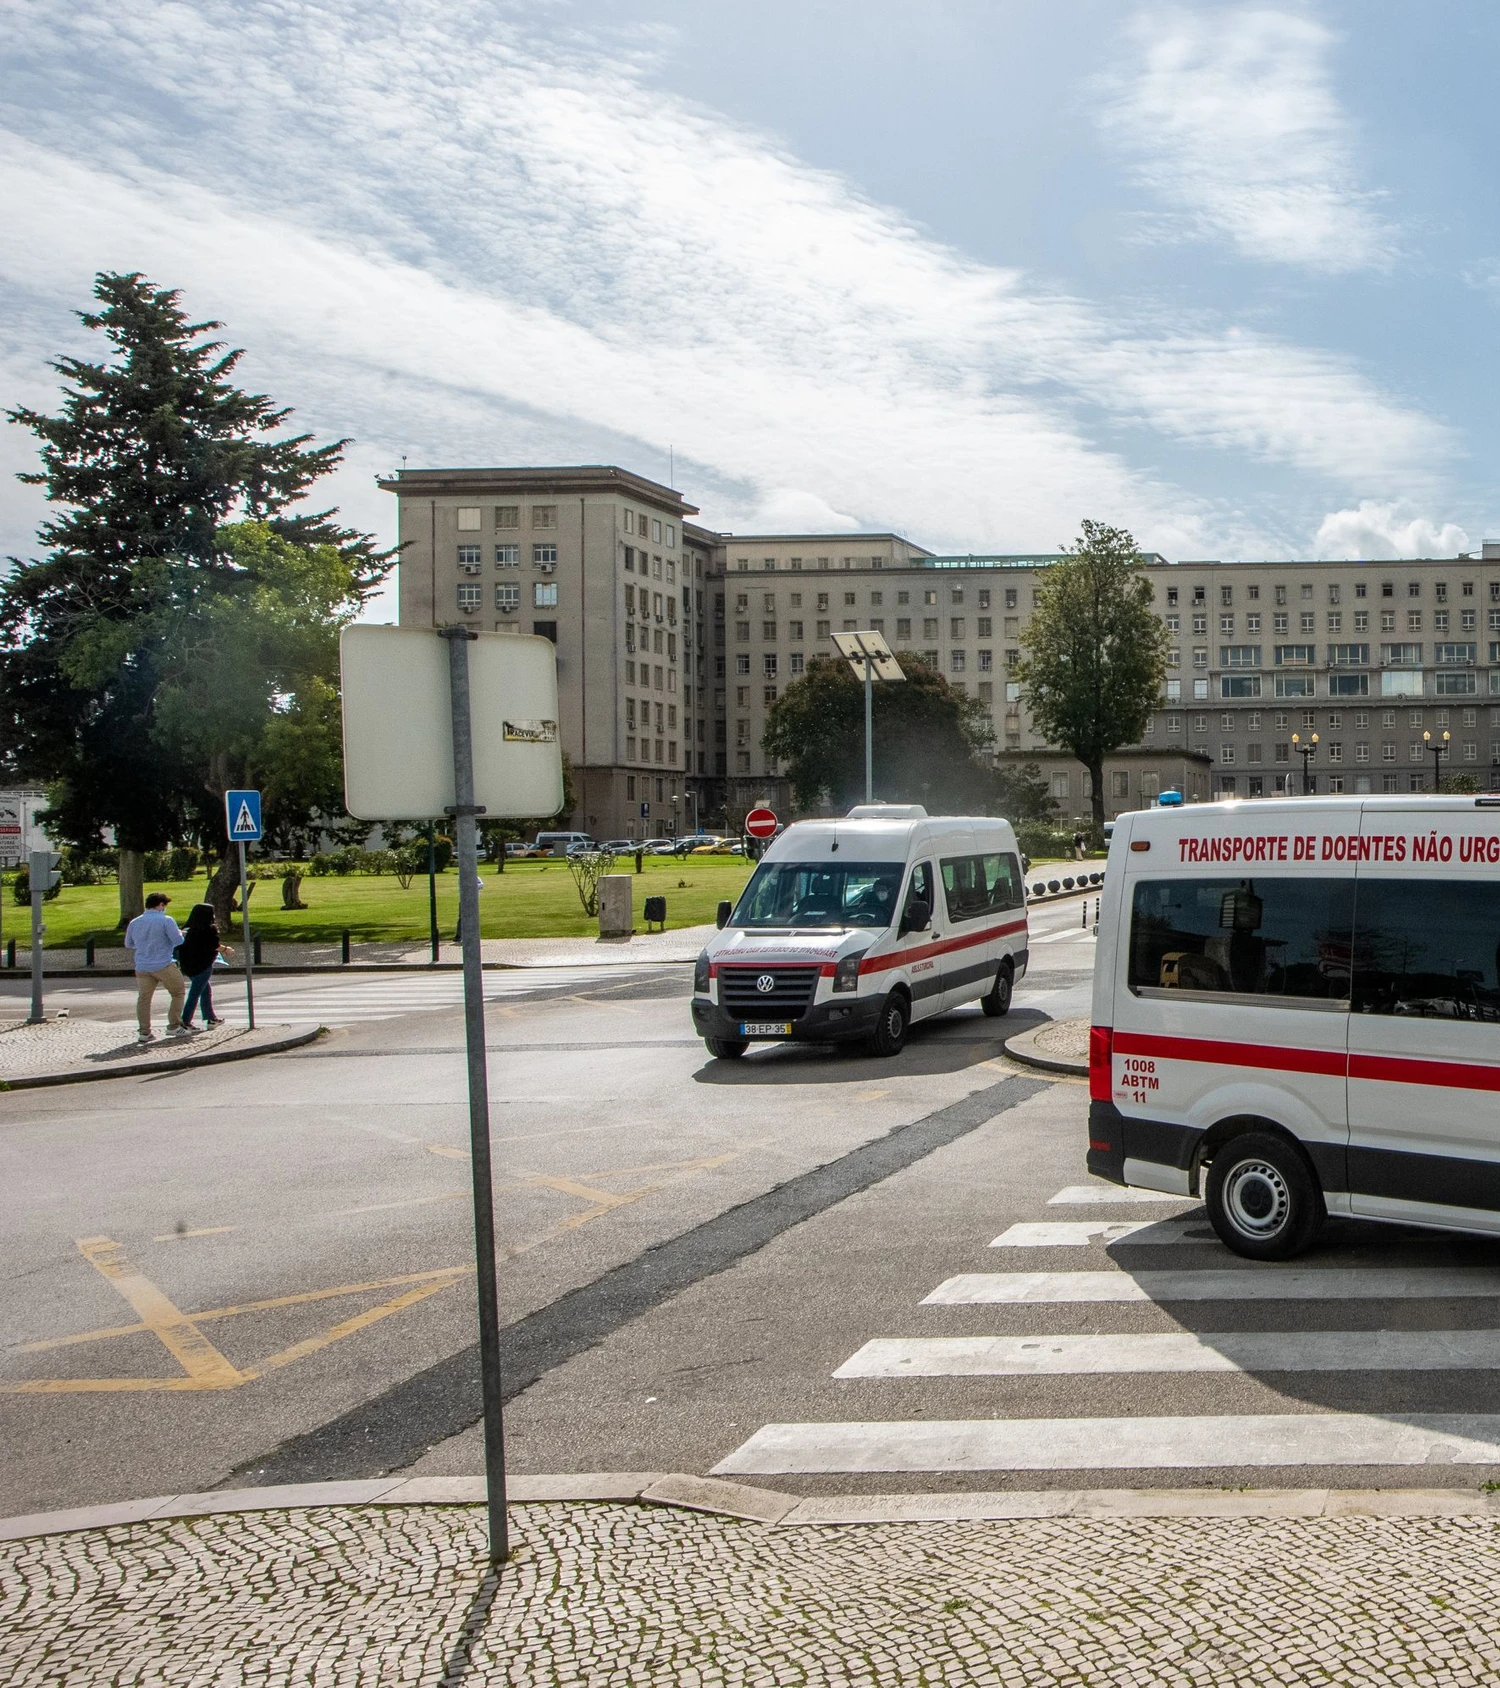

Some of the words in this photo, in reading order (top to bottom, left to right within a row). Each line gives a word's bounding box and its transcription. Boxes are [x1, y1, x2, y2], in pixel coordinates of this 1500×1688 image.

[1178, 836, 1288, 862] TRANSPORTE
[1293, 836, 1316, 861] DE
[1322, 836, 1406, 861] DOENTES
[1412, 830, 1453, 862] NÃO
[1124, 1058, 1155, 1073] 1008
[1121, 1074, 1159, 1090] ABTM
[1132, 1091, 1146, 1103] 11
